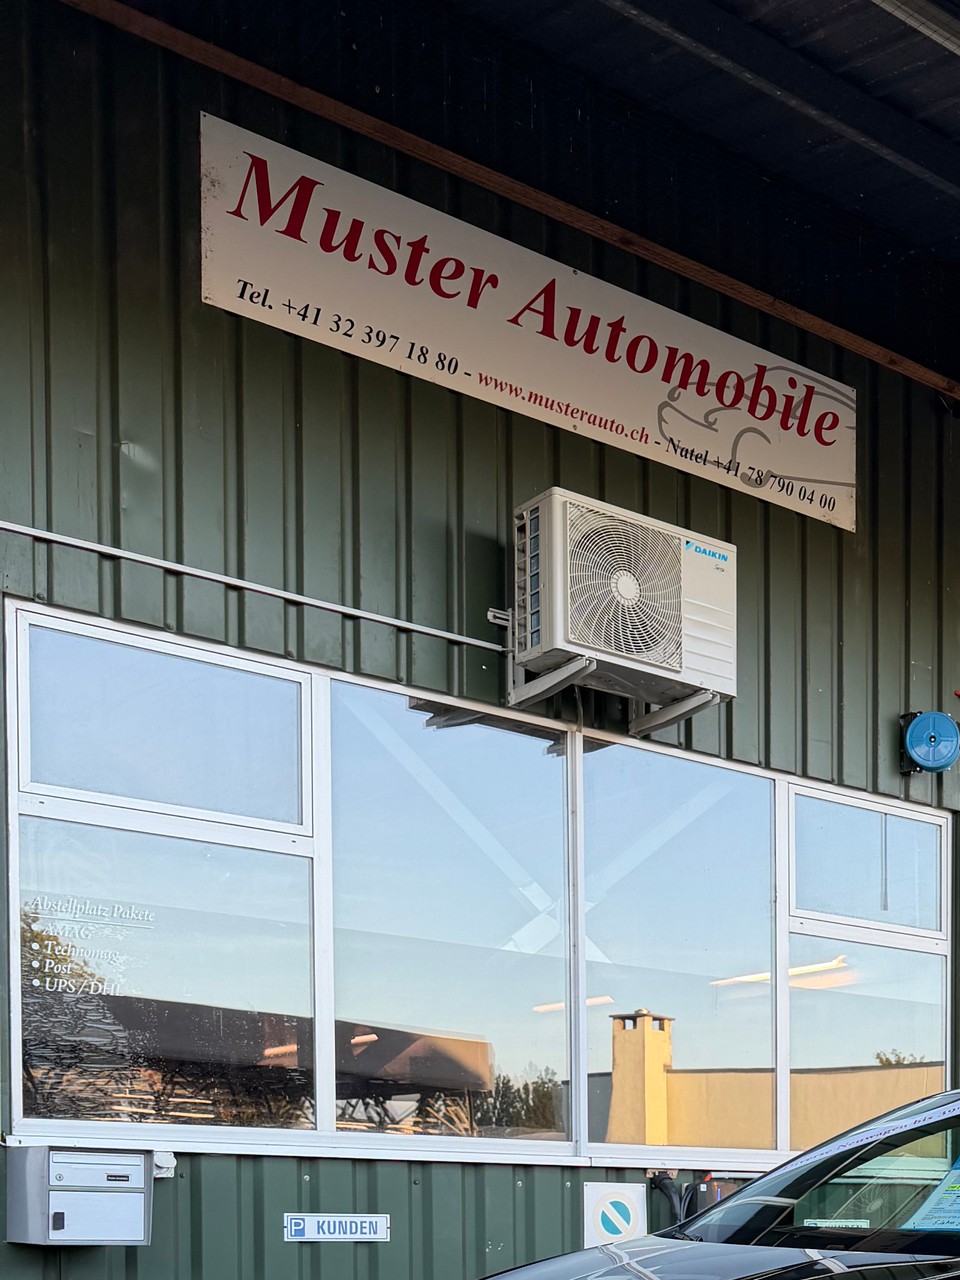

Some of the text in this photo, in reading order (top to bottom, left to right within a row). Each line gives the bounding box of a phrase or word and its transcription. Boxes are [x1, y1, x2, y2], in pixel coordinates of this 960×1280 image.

[226, 151, 840, 447] Muster Automobile
[237, 279, 273, 309] Tel.
[282, 298, 322, 326] +41
[329, 314, 355, 338] 32
[361, 325, 400, 352] 397
[405, 341, 429, 364] 18
[435, 352, 459, 375] 80
[477, 372, 650, 445] www.musterauto.ch
[666, 436, 709, 466] Natel
[713, 456, 740, 477] +41
[747, 466, 764, 486] 78
[769, 474, 794, 497] 790
[798, 485, 816, 505] 04
[819, 493, 836, 512] 00
[694, 545, 728, 562] DAIKIN
[31, 896, 155, 921] Abstellplatz Pakete
[44, 959, 72, 974] Post
[837, 1124, 908, 1151] Neuwagen
[317, 1220, 378, 1235] KUNDEN
